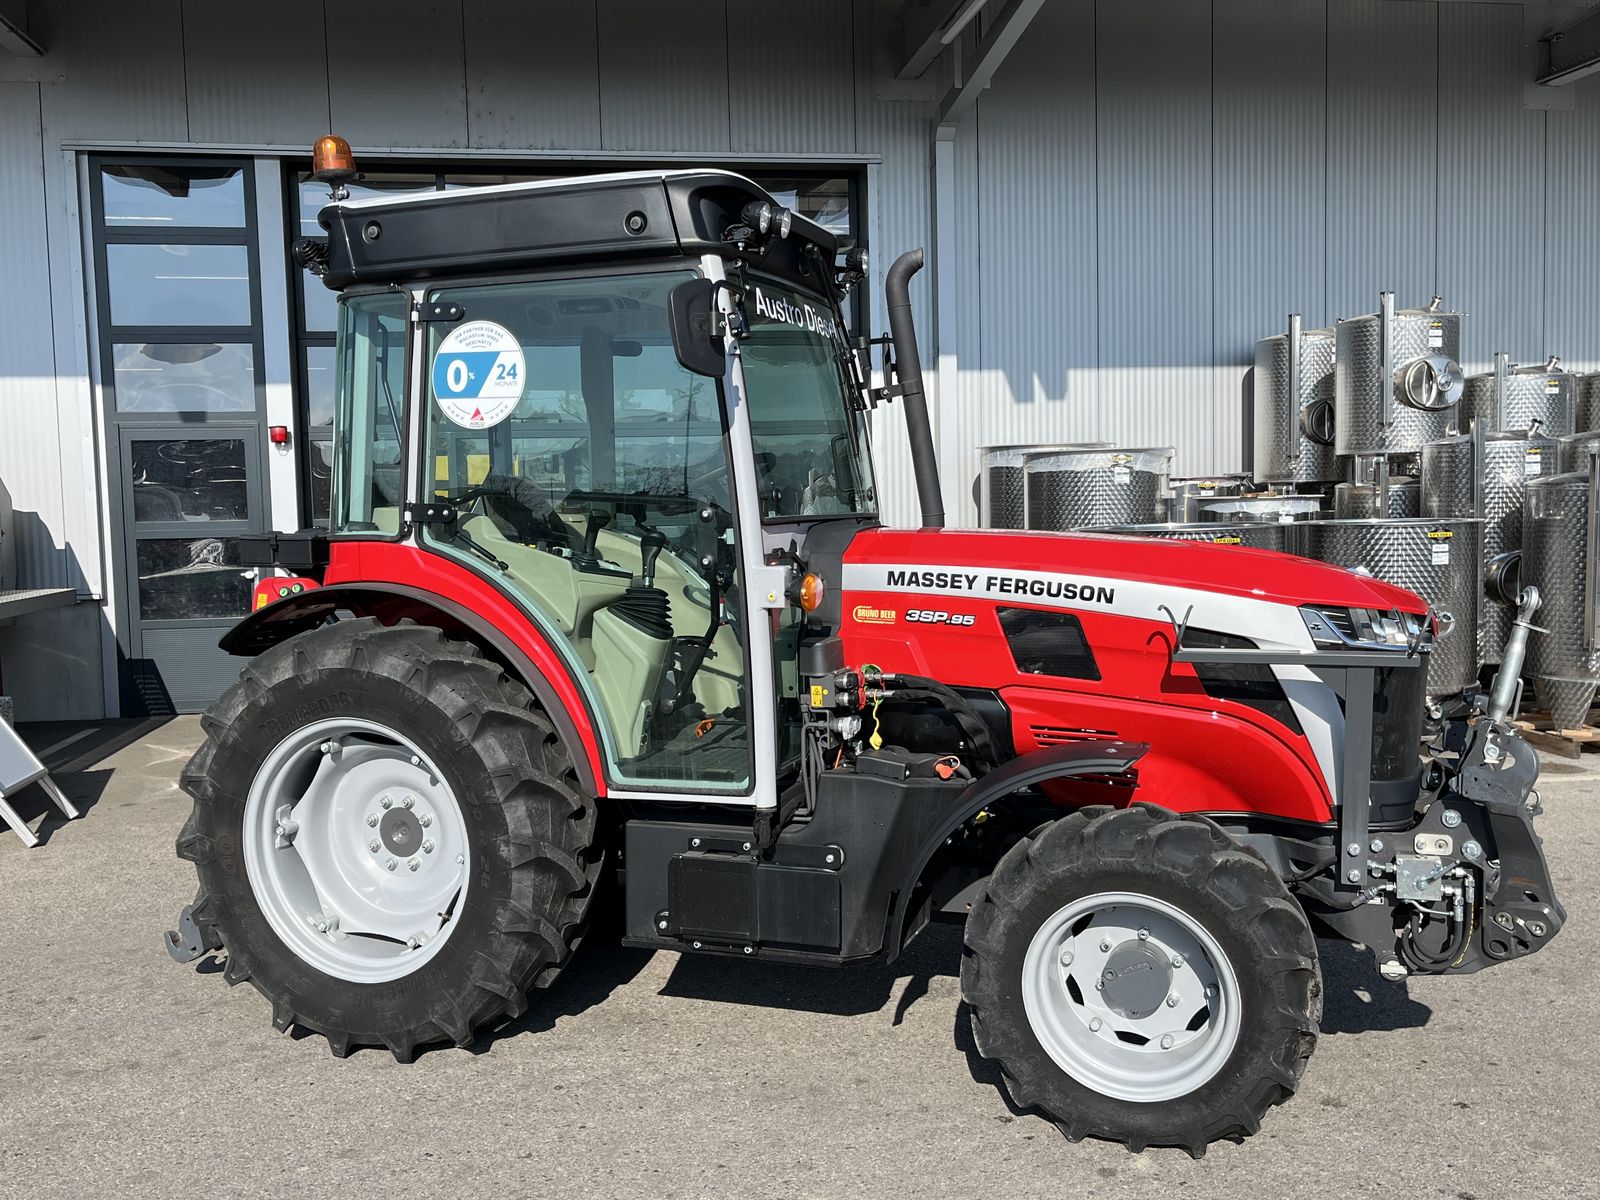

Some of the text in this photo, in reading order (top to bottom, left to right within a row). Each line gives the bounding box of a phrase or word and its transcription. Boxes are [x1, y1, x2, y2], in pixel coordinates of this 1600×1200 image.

[755, 287, 804, 328] Austro
[497, 363, 517, 380] 24
[886, 570, 1115, 604] MASSEY FERGUSON
[857, 608, 896, 619] BRUNO BEER
[904, 609, 976, 627] 3SP.95
